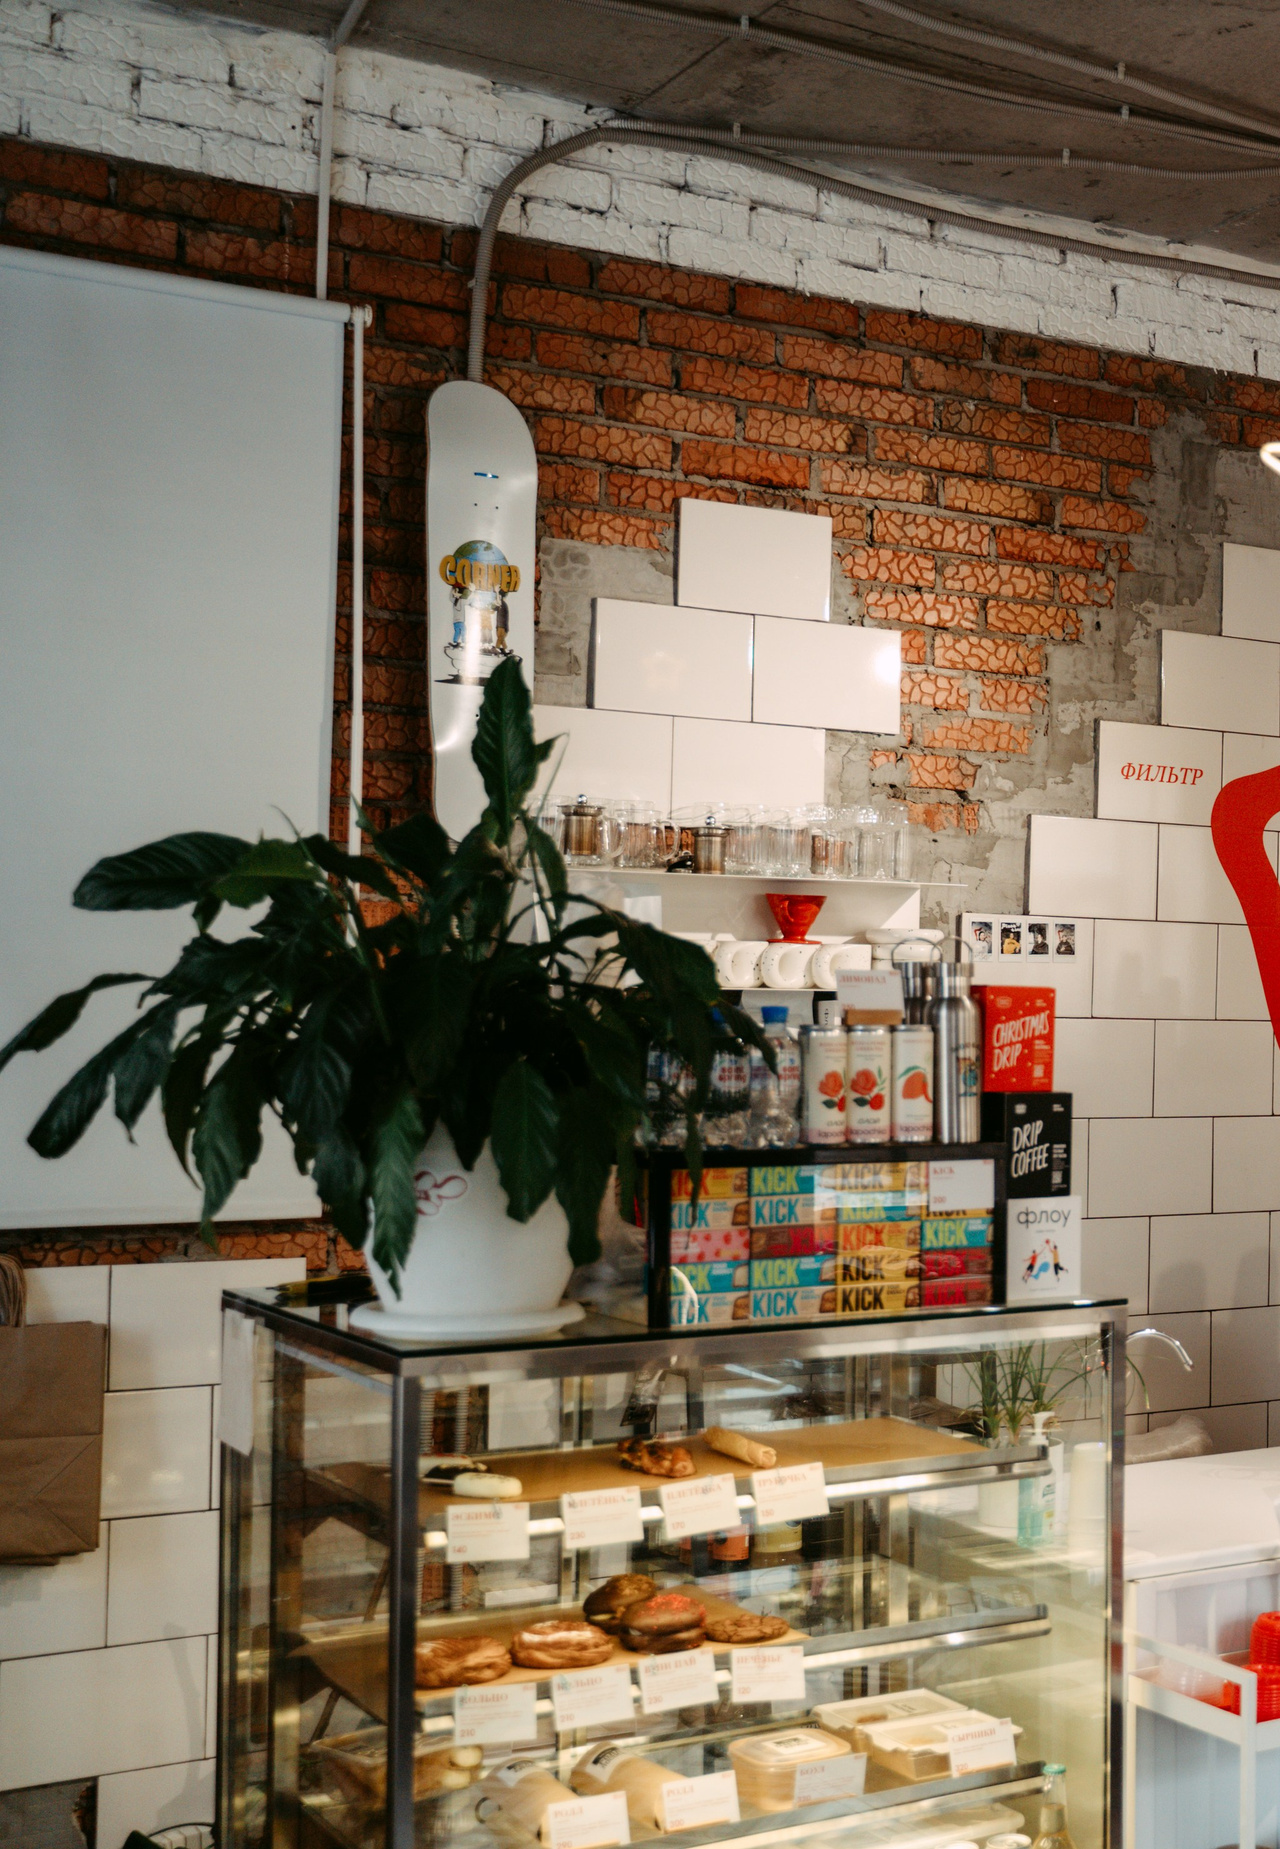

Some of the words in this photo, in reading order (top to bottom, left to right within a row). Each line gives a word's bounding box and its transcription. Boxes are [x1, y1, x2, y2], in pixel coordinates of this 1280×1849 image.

[439, 555, 521, 592] CORNER
[1121, 763, 1204, 785] ФИЛЬТР
[993, 1010, 1050, 1047] CHRISTMAS
[993, 1043, 1022, 1072] DRIP
[1012, 1119, 1044, 1152] DRIP
[933, 1167, 954, 1175] KICK
[1011, 1143, 1050, 1178] COFFEE
[753, 1166, 800, 1194] KICK
[841, 1165, 885, 1190] KICK
[755, 1198, 799, 1225] KICK
[842, 1193, 886, 1220] KICK
[1017, 1207, 1071, 1229] флоу
[842, 1225, 886, 1251] KICK
[925, 1219, 968, 1247] KICK
[753, 1258, 799, 1288] KICK
[842, 1256, 885, 1281] KICK
[753, 1291, 798, 1318] KICK
[842, 1286, 885, 1312] KICK
[952, 1728, 996, 1742] СЫРНИКИ
